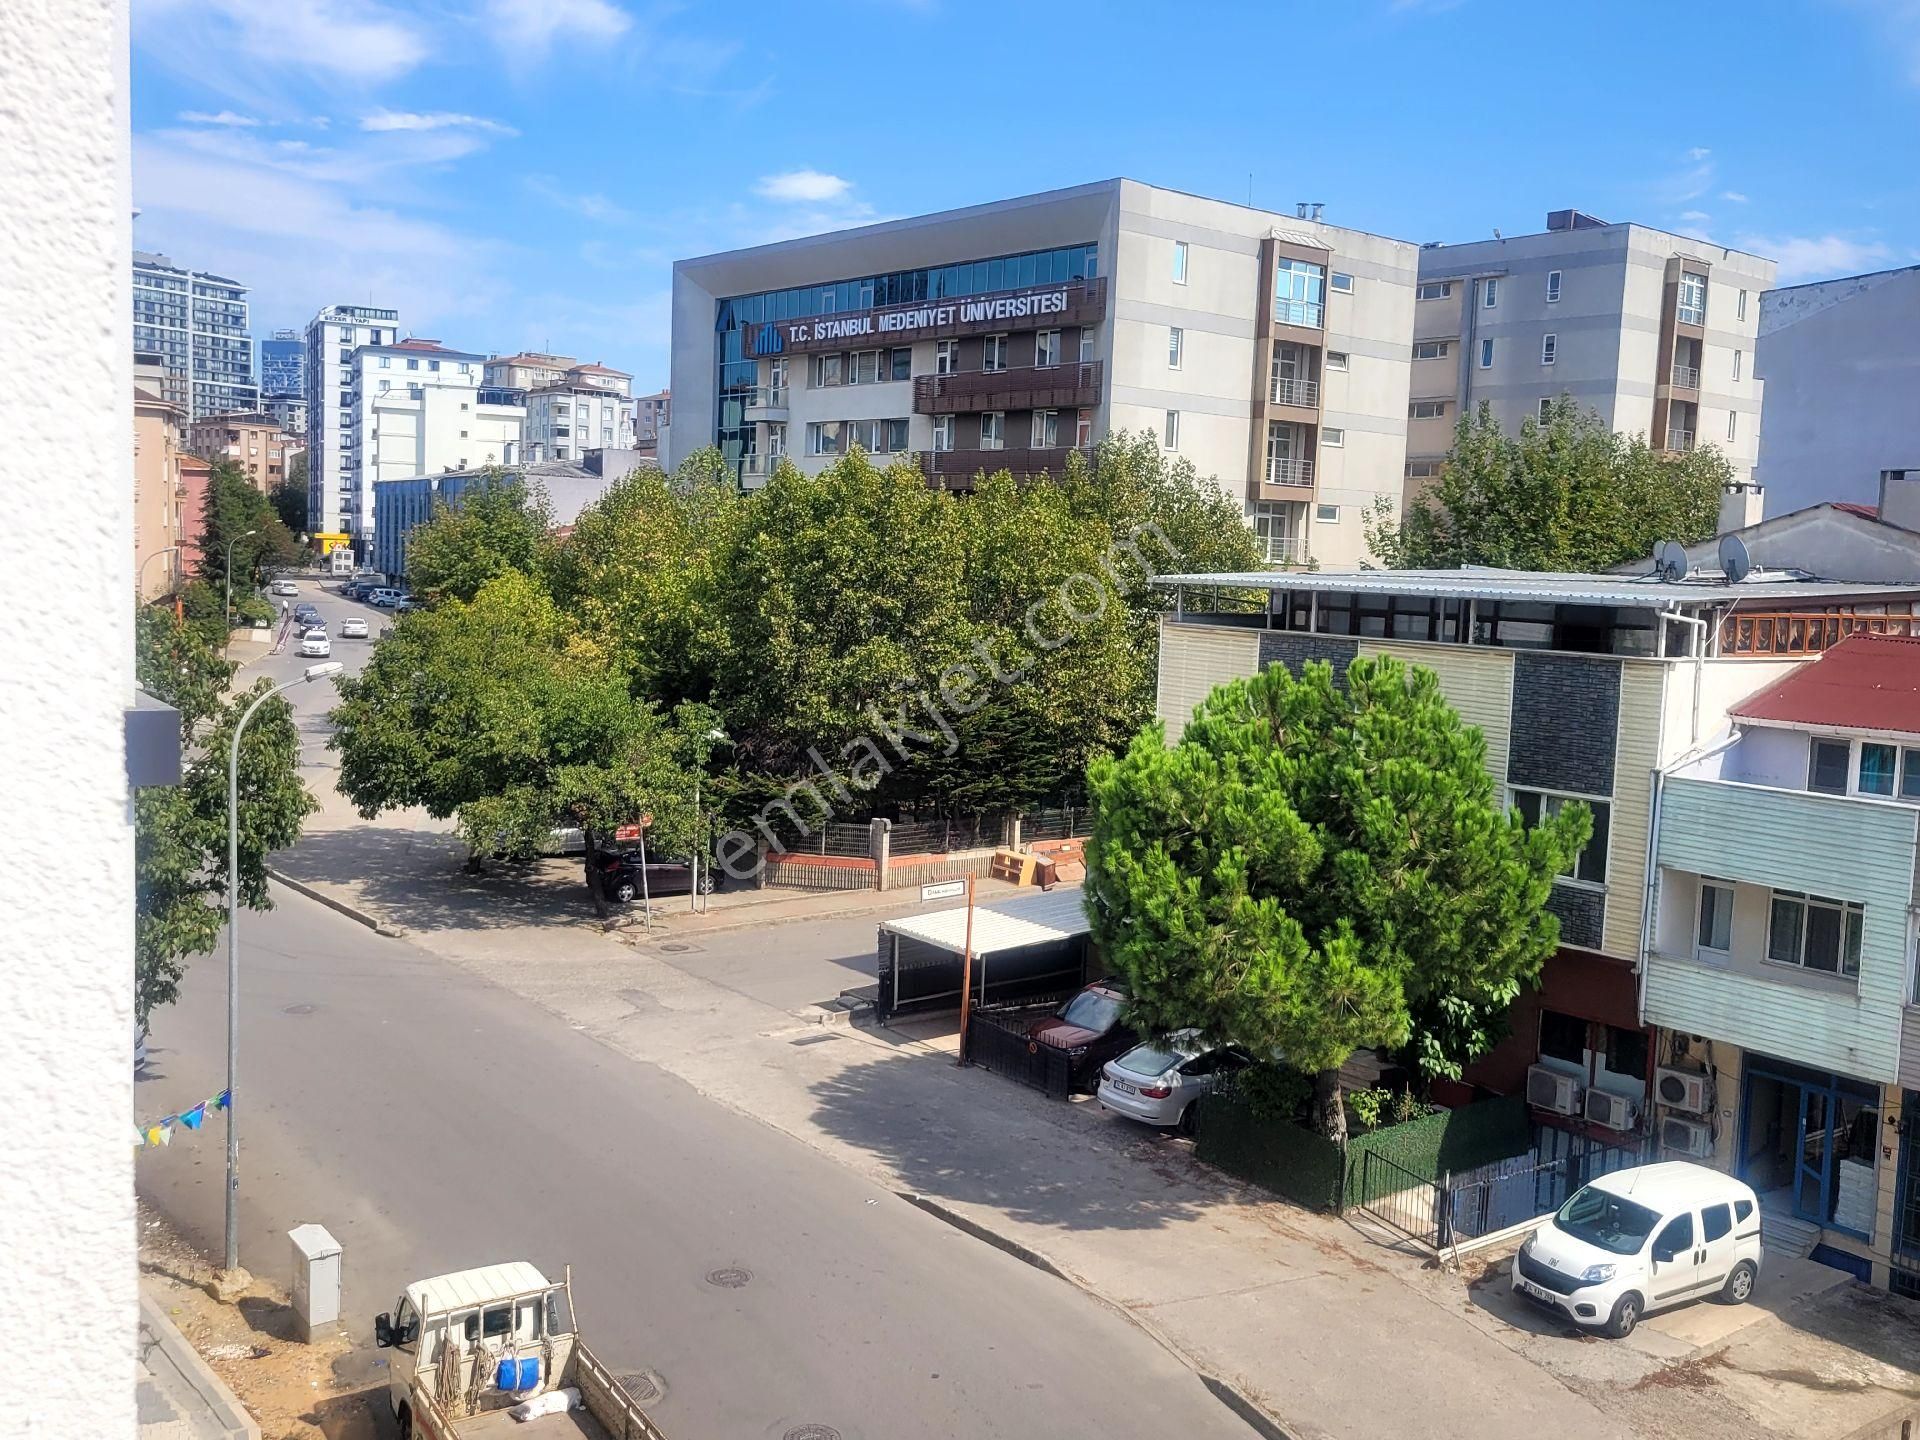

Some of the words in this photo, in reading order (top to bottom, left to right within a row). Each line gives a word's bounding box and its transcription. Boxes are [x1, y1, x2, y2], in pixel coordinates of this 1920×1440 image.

[789, 325, 811, 342] T.C.
[814, 319, 875, 340] İSTANBUL
[878, 304, 956, 333] MEDENİYET
[960, 286, 1068, 323] ÜNİVERSİTESİ
